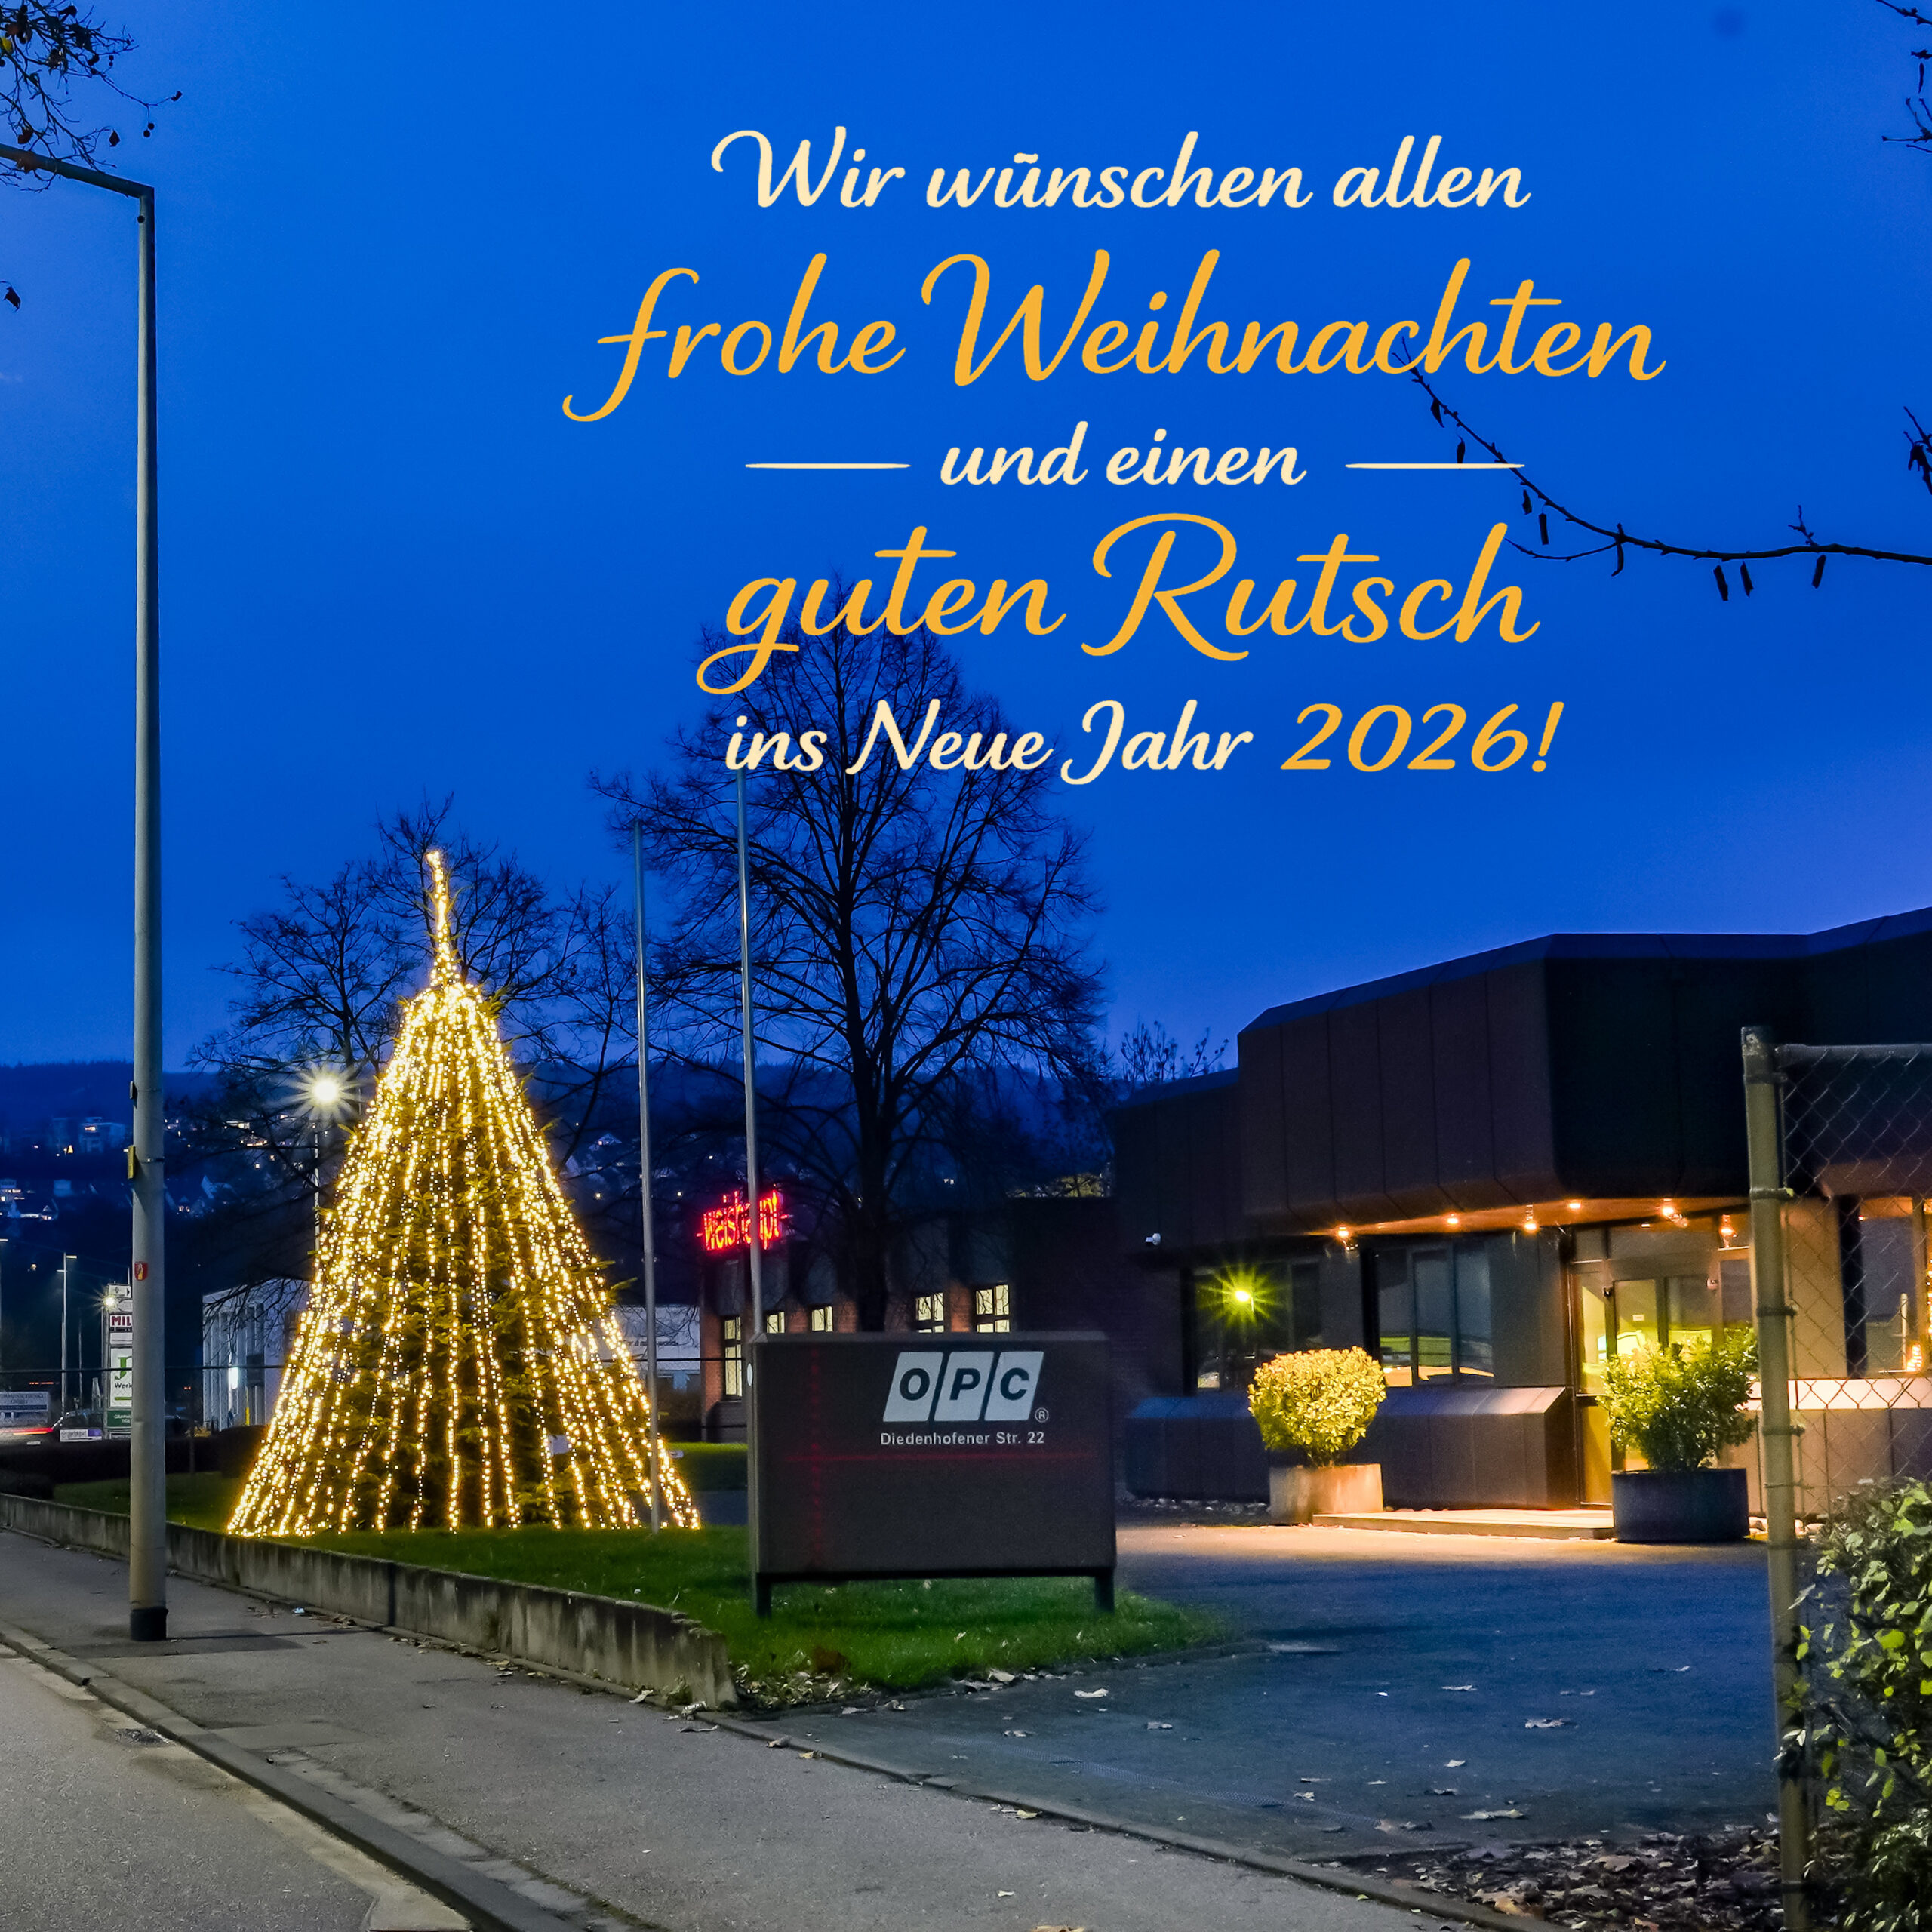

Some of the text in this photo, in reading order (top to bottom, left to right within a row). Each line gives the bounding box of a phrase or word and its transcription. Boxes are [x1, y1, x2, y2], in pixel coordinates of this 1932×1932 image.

[899, 1367, 1030, 1401] OPC
[880, 1431, 1045, 1445] Diedenhofener Str. 22
